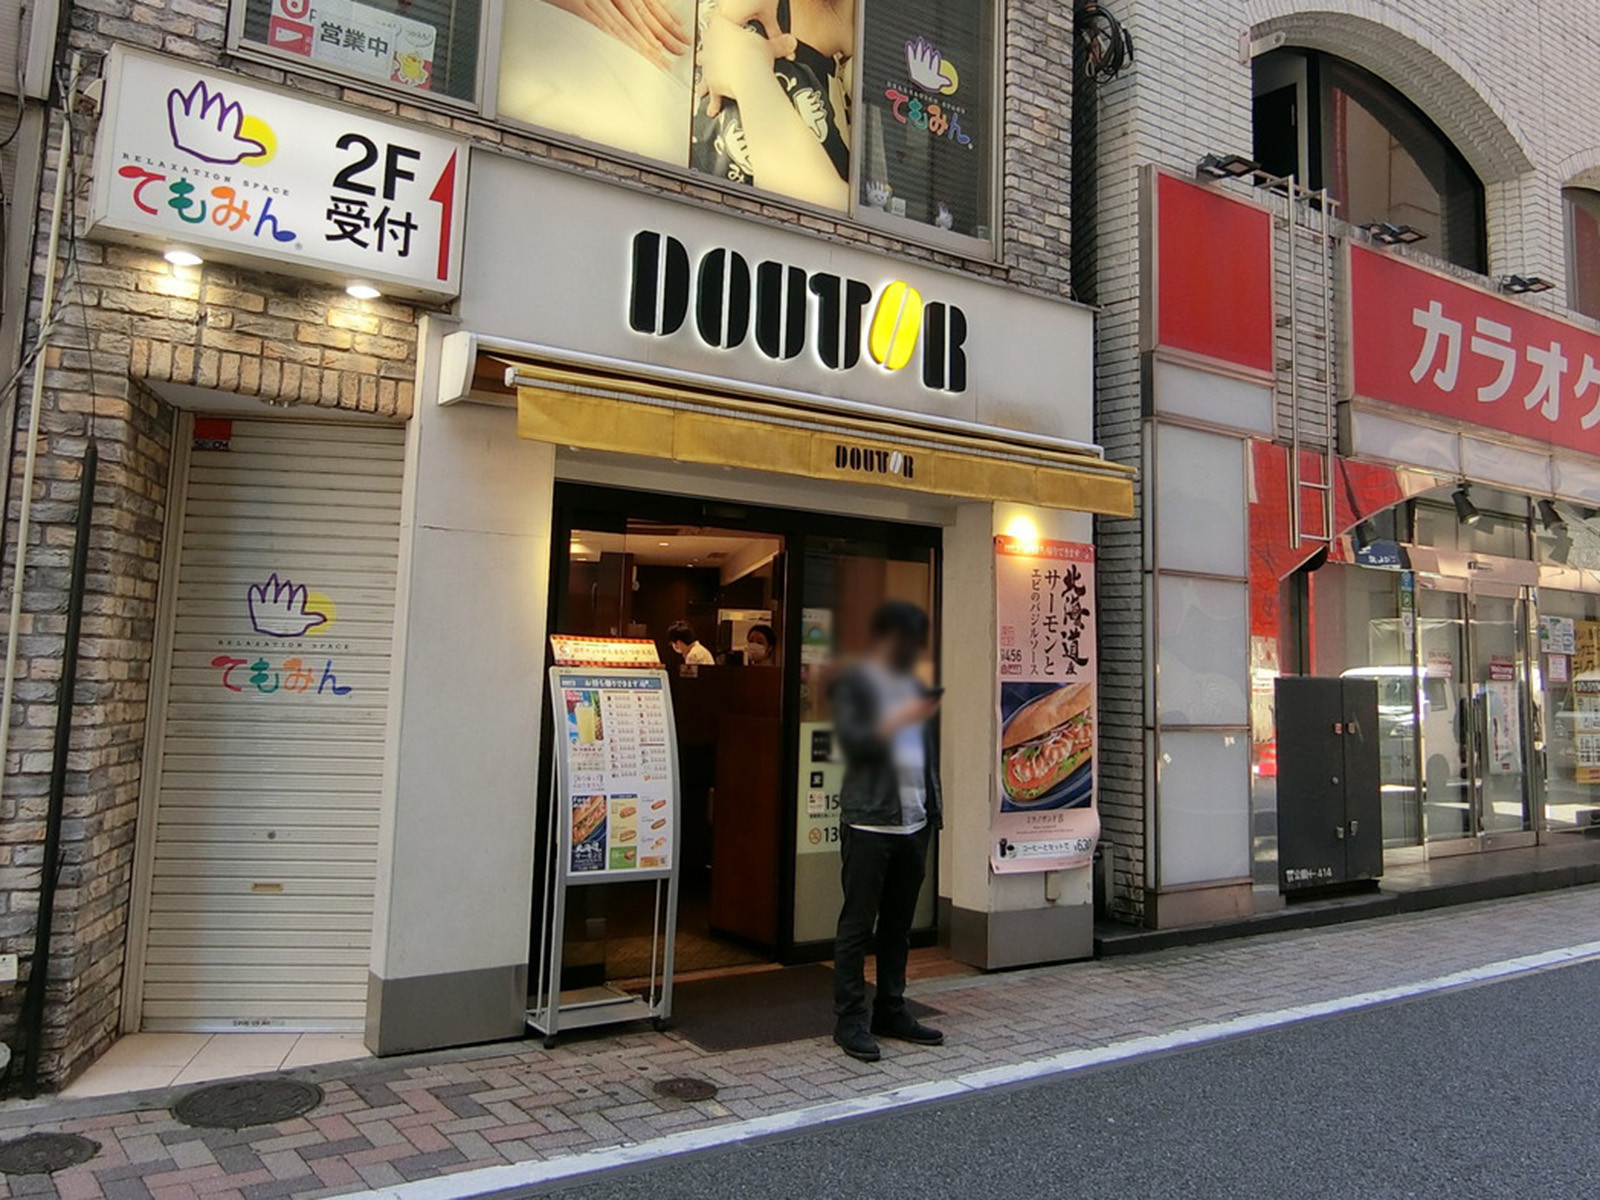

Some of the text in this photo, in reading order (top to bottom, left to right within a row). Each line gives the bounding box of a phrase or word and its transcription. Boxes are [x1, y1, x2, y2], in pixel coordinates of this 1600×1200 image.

[320, 21, 388, 57] 営業中
[885, 89, 970, 144] てもみん
[122, 152, 290, 197] RELAXATION SPACE
[332, 133, 421, 201] 2F
[118, 165, 297, 242] てもみん
[325, 195, 418, 258] 受付
[629, 229, 967, 393] DOUTOR
[835, 445, 914, 478] DOUTOR
[1029, 568, 1041, 676] エビのバジルソース
[1043, 569, 1061, 676] サーモンと
[211, 655, 353, 696] てもみん
